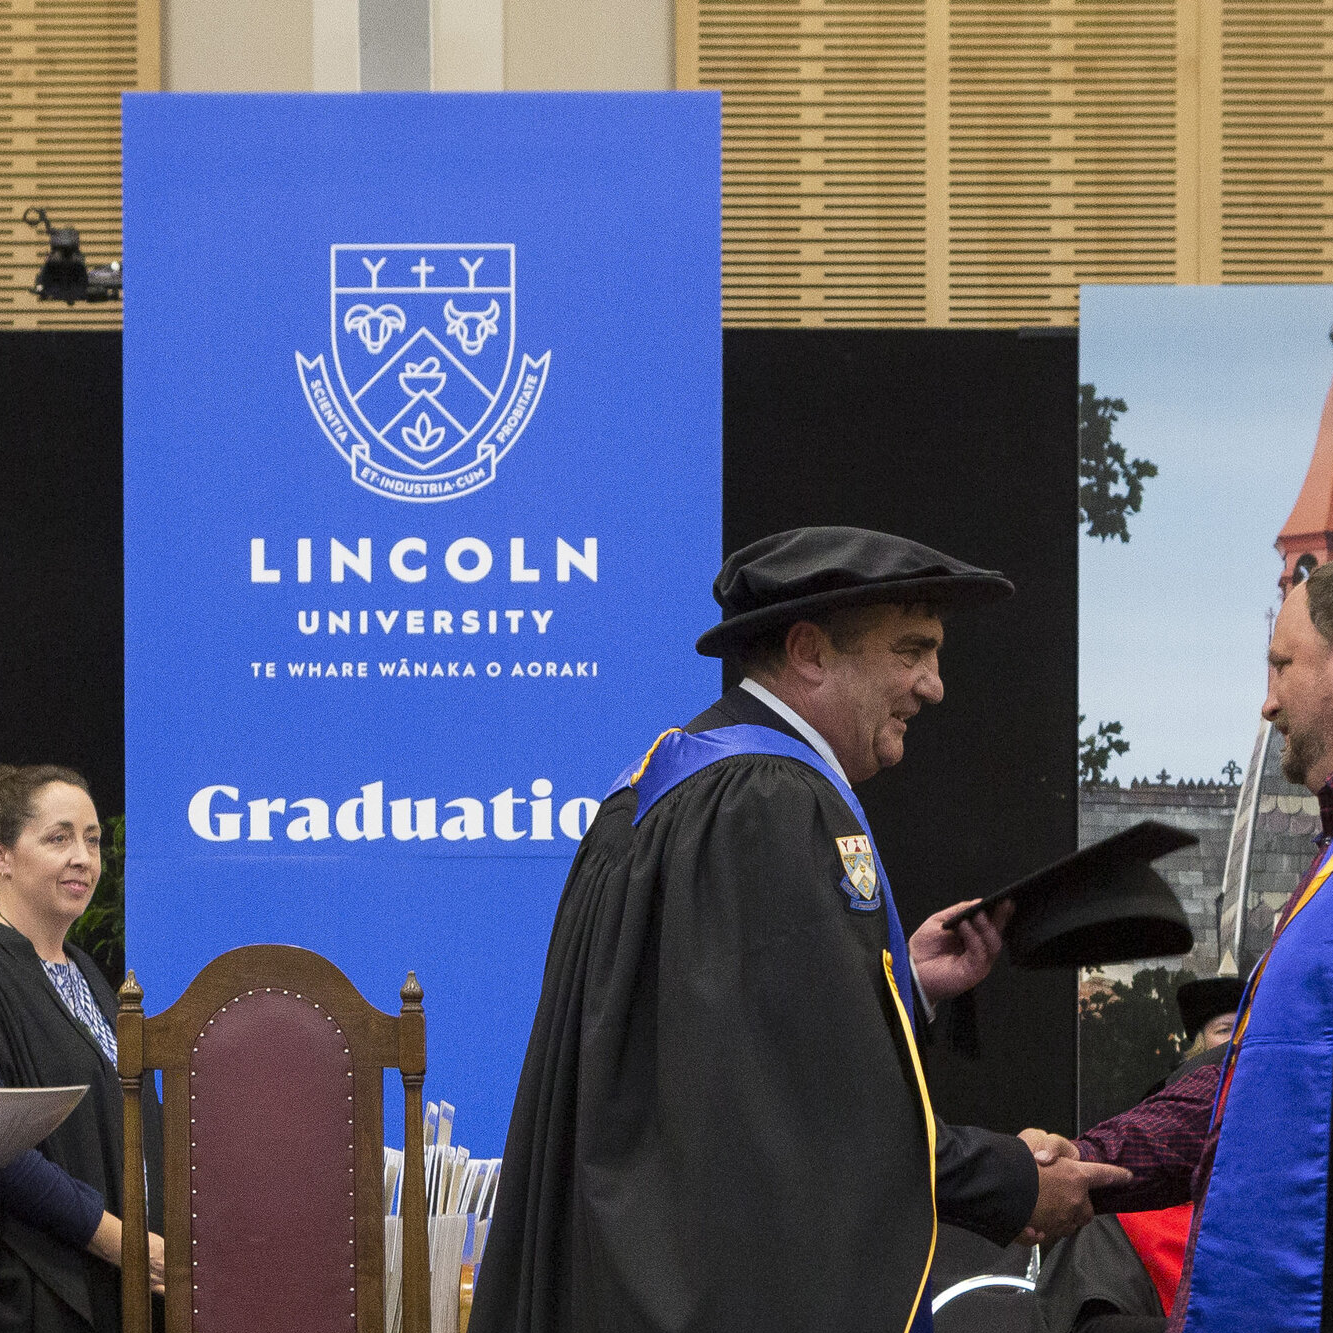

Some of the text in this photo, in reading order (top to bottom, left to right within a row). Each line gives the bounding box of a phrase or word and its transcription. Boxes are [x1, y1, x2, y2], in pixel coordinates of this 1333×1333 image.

[310, 379, 349, 444] SCIENTIA
[495, 373, 539, 444] PROBITATE
[250, 537, 598, 583] LINCOLN
[298, 609, 553, 635] UNIVERSITY
[251, 658, 598, 678] TE WHARE WĀNAKA O AORAKI
[188, 778, 602, 842] Graduatio
